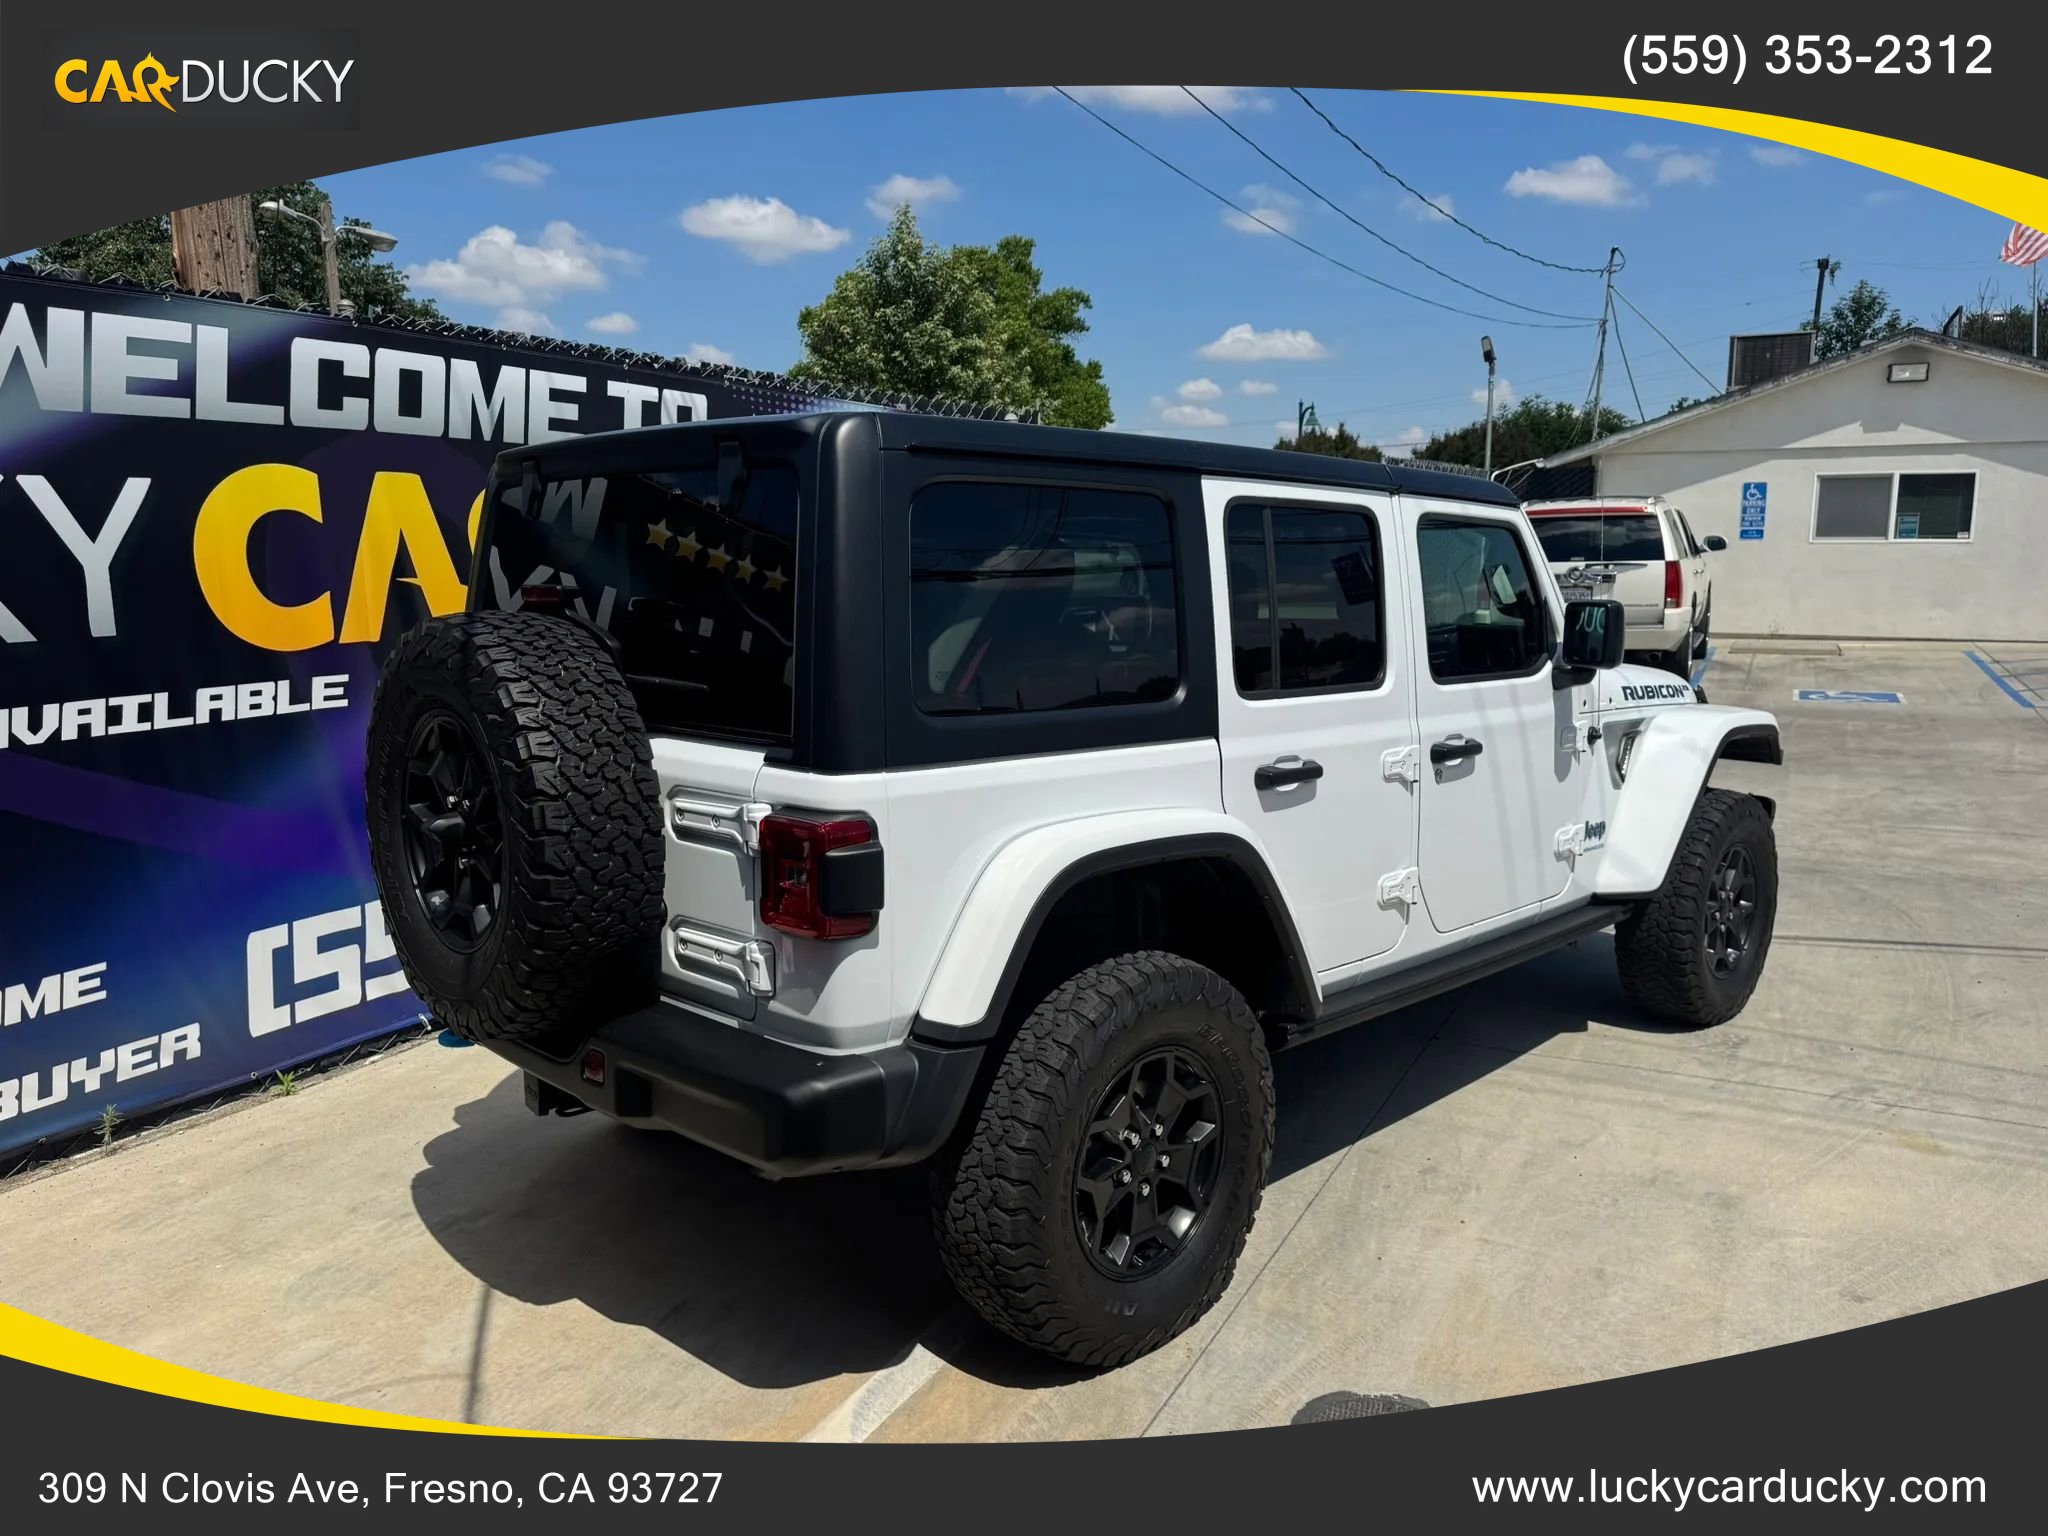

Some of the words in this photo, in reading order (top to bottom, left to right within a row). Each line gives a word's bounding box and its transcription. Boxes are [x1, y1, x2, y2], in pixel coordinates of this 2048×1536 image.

[0, 302, 588, 446] WELCOME
[193, 463, 487, 652] CA
[0, 674, 349, 749] VAILABLE
[1621, 684, 1685, 702] RUBICON
[1583, 820, 1606, 841] Jeep
[0, 961, 107, 1027] ME
